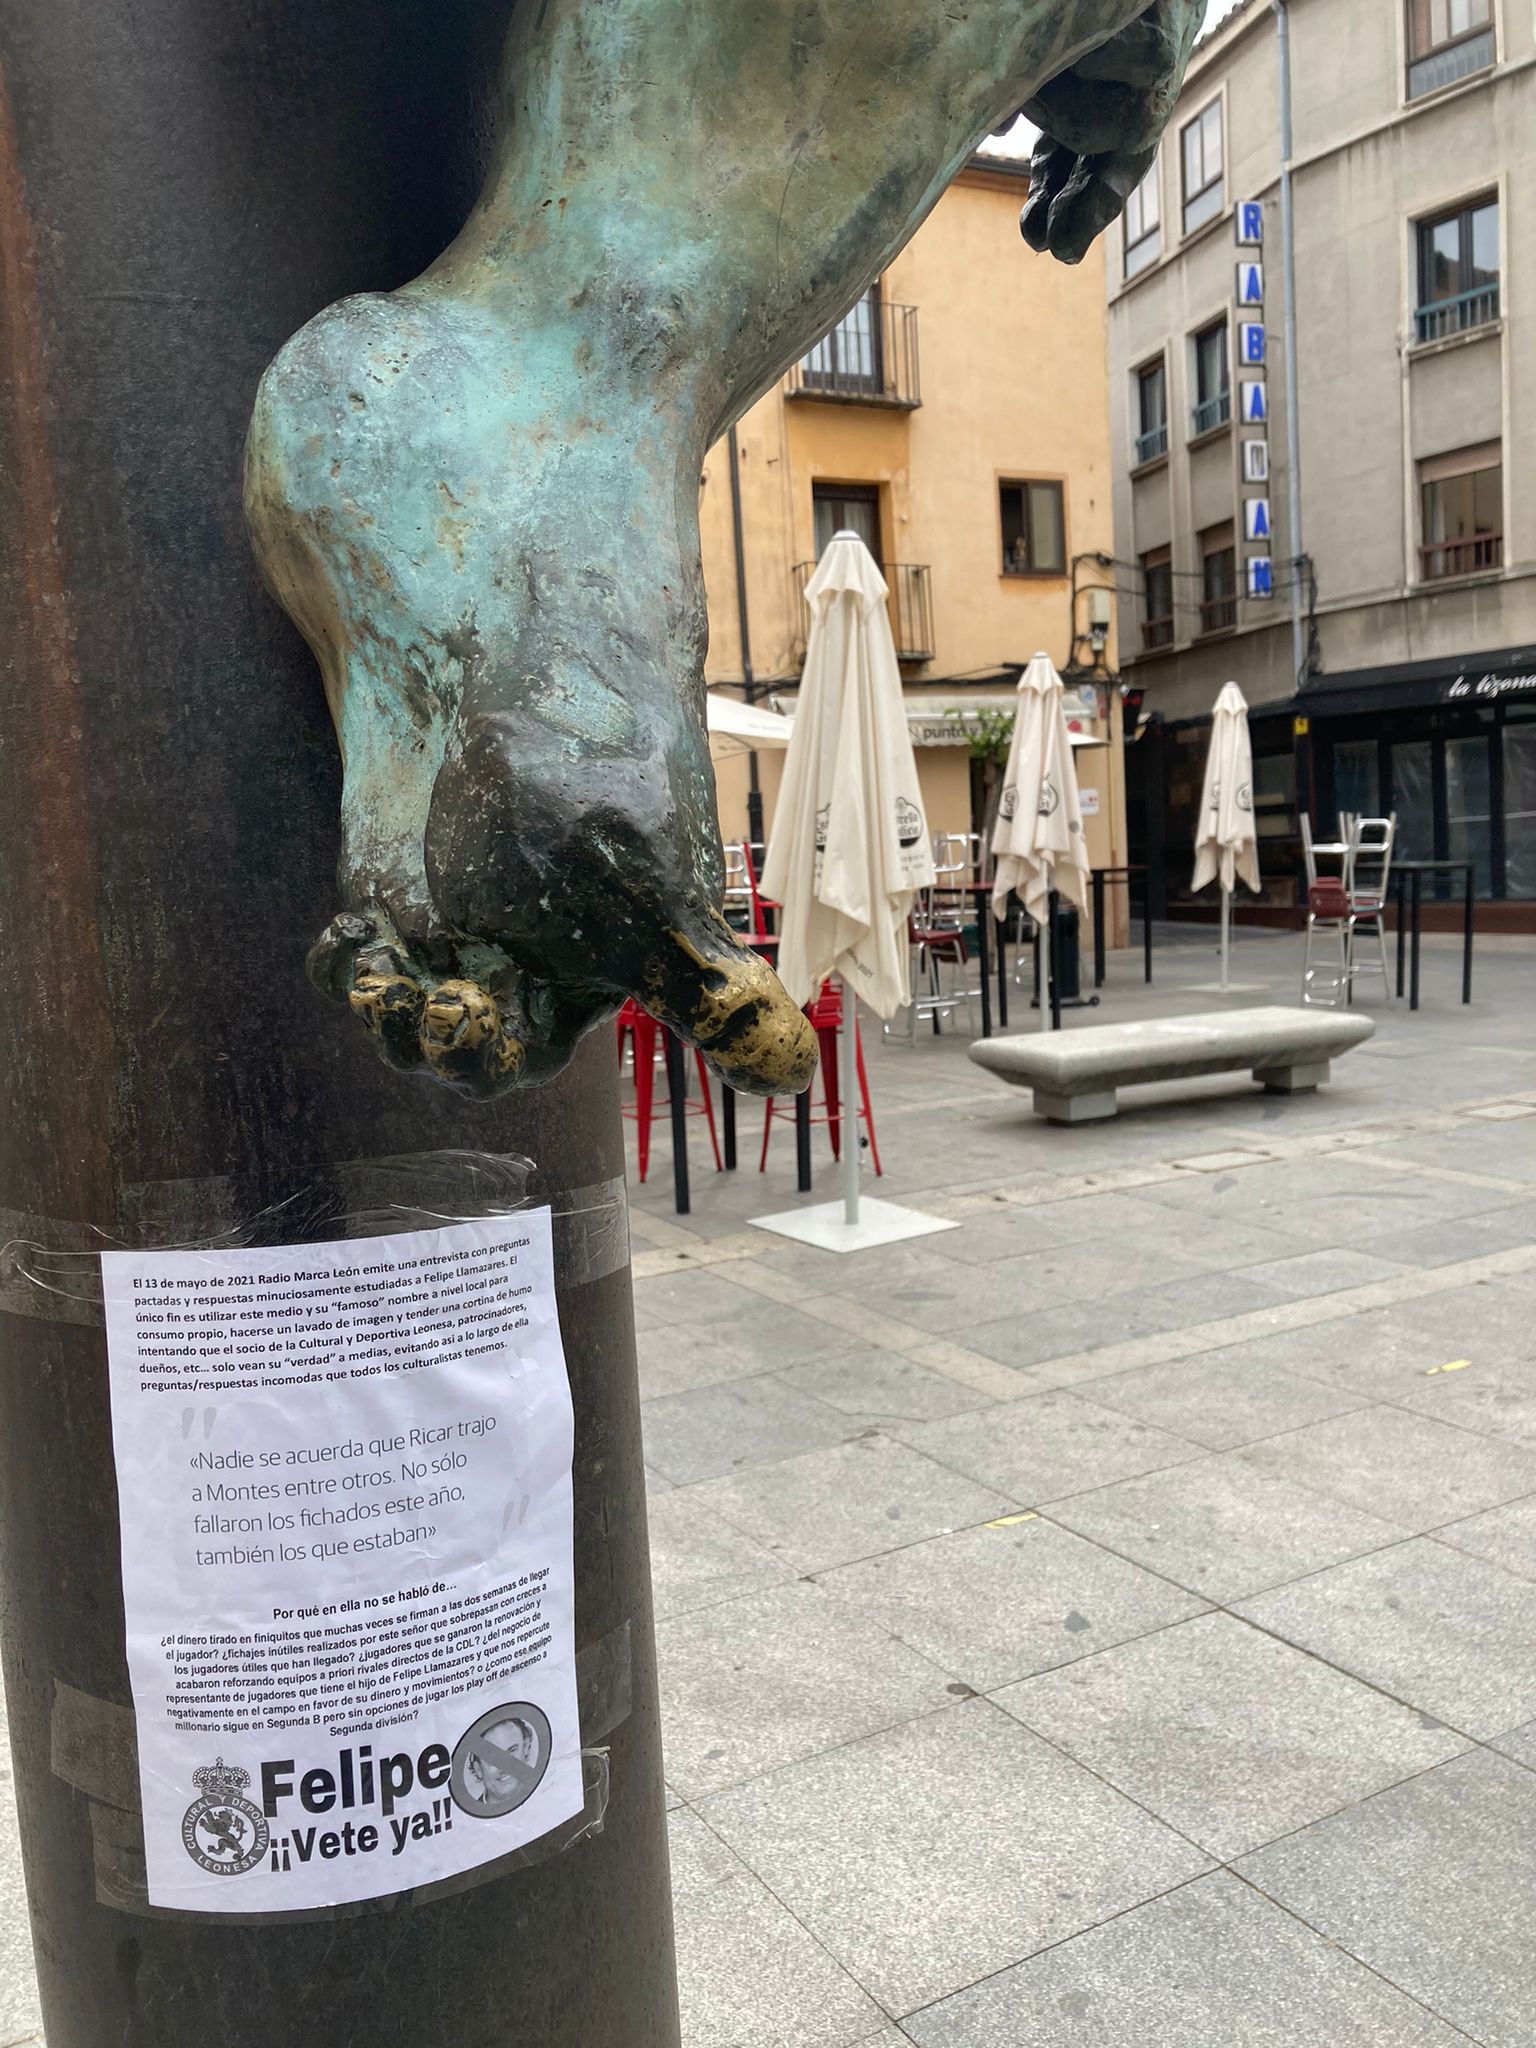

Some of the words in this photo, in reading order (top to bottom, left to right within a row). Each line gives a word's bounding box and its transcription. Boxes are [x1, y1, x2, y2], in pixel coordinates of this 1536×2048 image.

[1448, 674, 1471, 697] la
[133, 1278, 142, 1288] El
[145, 1278, 158, 1289] 13
[160, 1278, 174, 1288] de
[177, 1280, 207, 1290] mayo
[210, 1277, 224, 1287] de
[227, 1275, 255, 1286] 2021
[258, 1273, 291, 1284] Radio
[294, 1271, 330, 1281] Marca
[333, 1266, 360, 1278] León
[363, 1263, 395, 1275] emite
[398, 1260, 417, 1270] una
[420, 1252, 469, 1267] entrevista
[471, 1248, 487, 1258] con
[489, 1238, 530, 1256] preguntas
[135, 1296, 181, 1307] pactadas
[184, 1298, 190, 1307] y
[193, 1294, 254, 1306] respuestas
[256, 1286, 351, 1302] minuciosamente
[354, 1278, 413, 1293] estudiadas
[415, 1277, 421, 1285] a
[424, 1271, 454, 1283] Felipe
[456, 1260, 508, 1277] Llamazares.
[510, 1255, 517, 1265] El
[136, 1312, 164, 1322] único
[166, 1312, 181, 1322] fin
[183, 1314, 196, 1322] es
[199, 1311, 237, 1322] utilizar
[240, 1310, 264, 1320] este
[267, 1306, 303, 1318] medio
[306, 1307, 313, 1317] y
[315, 1306, 328, 1314] su
[388, 1292, 429, 1306] nombre
[432, 1291, 438, 1299] a
[441, 1283, 464, 1297] nivel
[465, 1278, 487, 1292] local
[489, 1275, 508, 1288] para
[137, 1332, 184, 1340] consumo
[188, 1328, 227, 1340] propio,
[230, 1327, 274, 1337] hacerse
[277, 1326, 291, 1334] un
[295, 1320, 333, 1333] lavado
[336, 1318, 350, 1329] de
[353, 1315, 394, 1326] imagen
[396, 1314, 403, 1324] y
[405, 1307, 440, 1320] tender
[442, 1303, 460, 1313] una
[462, 1296, 495, 1309] cortina
[496, 1291, 507, 1301] de
[509, 1285, 532, 1298] humo
[138, 1346, 197, 1356] intentando
[199, 1347, 220, 1357] que
[223, 1344, 233, 1354] el
[236, 1343, 265, 1354] socio
[268, 1342, 283, 1352] de
[286, 1340, 296, 1350] la
[299, 1335, 343, 1349] Cultural
[346, 1336, 353, 1346] y
[356, 1328, 410, 1343] Deportiva
[413, 1320, 455, 1335] Leonesa,
[458, 1303, 527, 1328] patrocinadores,
[139, 1363, 181, 1375] dueños,
[212, 1362, 235, 1372] solo
[238, 1362, 265, 1371] vean
[268, 1361, 281, 1369] su
[338, 1354, 345, 1362] a
[349, 1347, 391, 1361] medias,
[394, 1339, 439, 1355] evitando
[441, 1334, 455, 1346] asi
[457, 1335, 463, 1343] a
[465, 1331, 475, 1341] lo
[477, 1326, 500, 1338] largo
[501, 1322, 513, 1332] de
[514, 1318, 529, 1329] ella
[141, 1379, 258, 1392] preguntas/respuestas
[261, 1372, 323, 1386] incomodas
[326, 1371, 347, 1382] que
[350, 1366, 381, 1378] todos
[384, 1362, 400, 1372] los
[402, 1351, 462, 1370] culturalistas
[464, 1341, 507, 1357] tenemos.
[259, 1452, 281, 1467] se
[286, 1439, 363, 1465] acuerda
[369, 1436, 405, 1458] que
[410, 1426, 453, 1447] Ricar
[457, 1416, 496, 1437] trajo
[192, 1488, 202, 1502] a
[207, 1484, 280, 1501] Montes
[285, 1479, 337, 1497] entre
[342, 1470, 396, 1490] otros.
[402, 1462, 427, 1481] No
[431, 1452, 467, 1474] sólo
[194, 1514, 263, 1533] fallaron
[268, 1512, 295, 1530] los
[300, 1502, 381, 1527] fichados
[385, 1496, 424, 1515] este
[428, 1487, 465, 1507] año,
[196, 1545, 274, 1565] también
[280, 1543, 306, 1562] los
[311, 1541, 349, 1561] que
[166, 1650, 174, 1660] el
[176, 1649, 219, 1662] jugador?
[222, 1648, 266, 1661] ¿fichajes
[268, 1645, 304, 1656] inútiles
[307, 1639, 357, 1652] realizados
[360, 1635, 377, 1648] por
[379, 1630, 399, 1642] este
[401, 1624, 428, 1637] señor
[430, 1619, 448, 1631] que
[450, 1603, 499, 1625] sobrepasan
[500, 1597, 515, 1608] con
[516, 1585, 541, 1602] creces
[542, 1583, 547, 1591] a
[273, 1608, 294, 1620] Por
[297, 1605, 319, 1620] qué
[322, 1605, 337, 1616] en
[340, 1599, 360, 1612] ella
[364, 1598, 379, 1608] no
[382, 1594, 395, 1605] se
[398, 1585, 429, 1602] habló
[174, 1665, 189, 1675] los
[191, 1664, 239, 1677] jugadores
[242, 1662, 268, 1672] útiles
[270, 1662, 289, 1673] que
[292, 1659, 310, 1669] han
[313, 1652, 355, 1667] llegado?
[359, 1642, 412, 1663] ¿jugadores
[414, 1638, 432, 1649] que
[434, 1634, 445, 1644] se
[447, 1623, 483, 1642] ganaron
[484, 1619, 492, 1628] la
[495, 1601, 535, 1624] renovación
[535, 1599, 542, 1609] y
[261, 1743, 451, 1817] Felipe
[184, 1798, 214, 1850] CULTURAL
[218, 1795, 226, 1803] Y
[231, 1797, 267, 1850] DEPORTIVA
[270, 1821, 379, 1872] ¡¡Vete
[390, 1797, 453, 1856] ya!!
[197, 1855, 258, 1873] LEONESA
